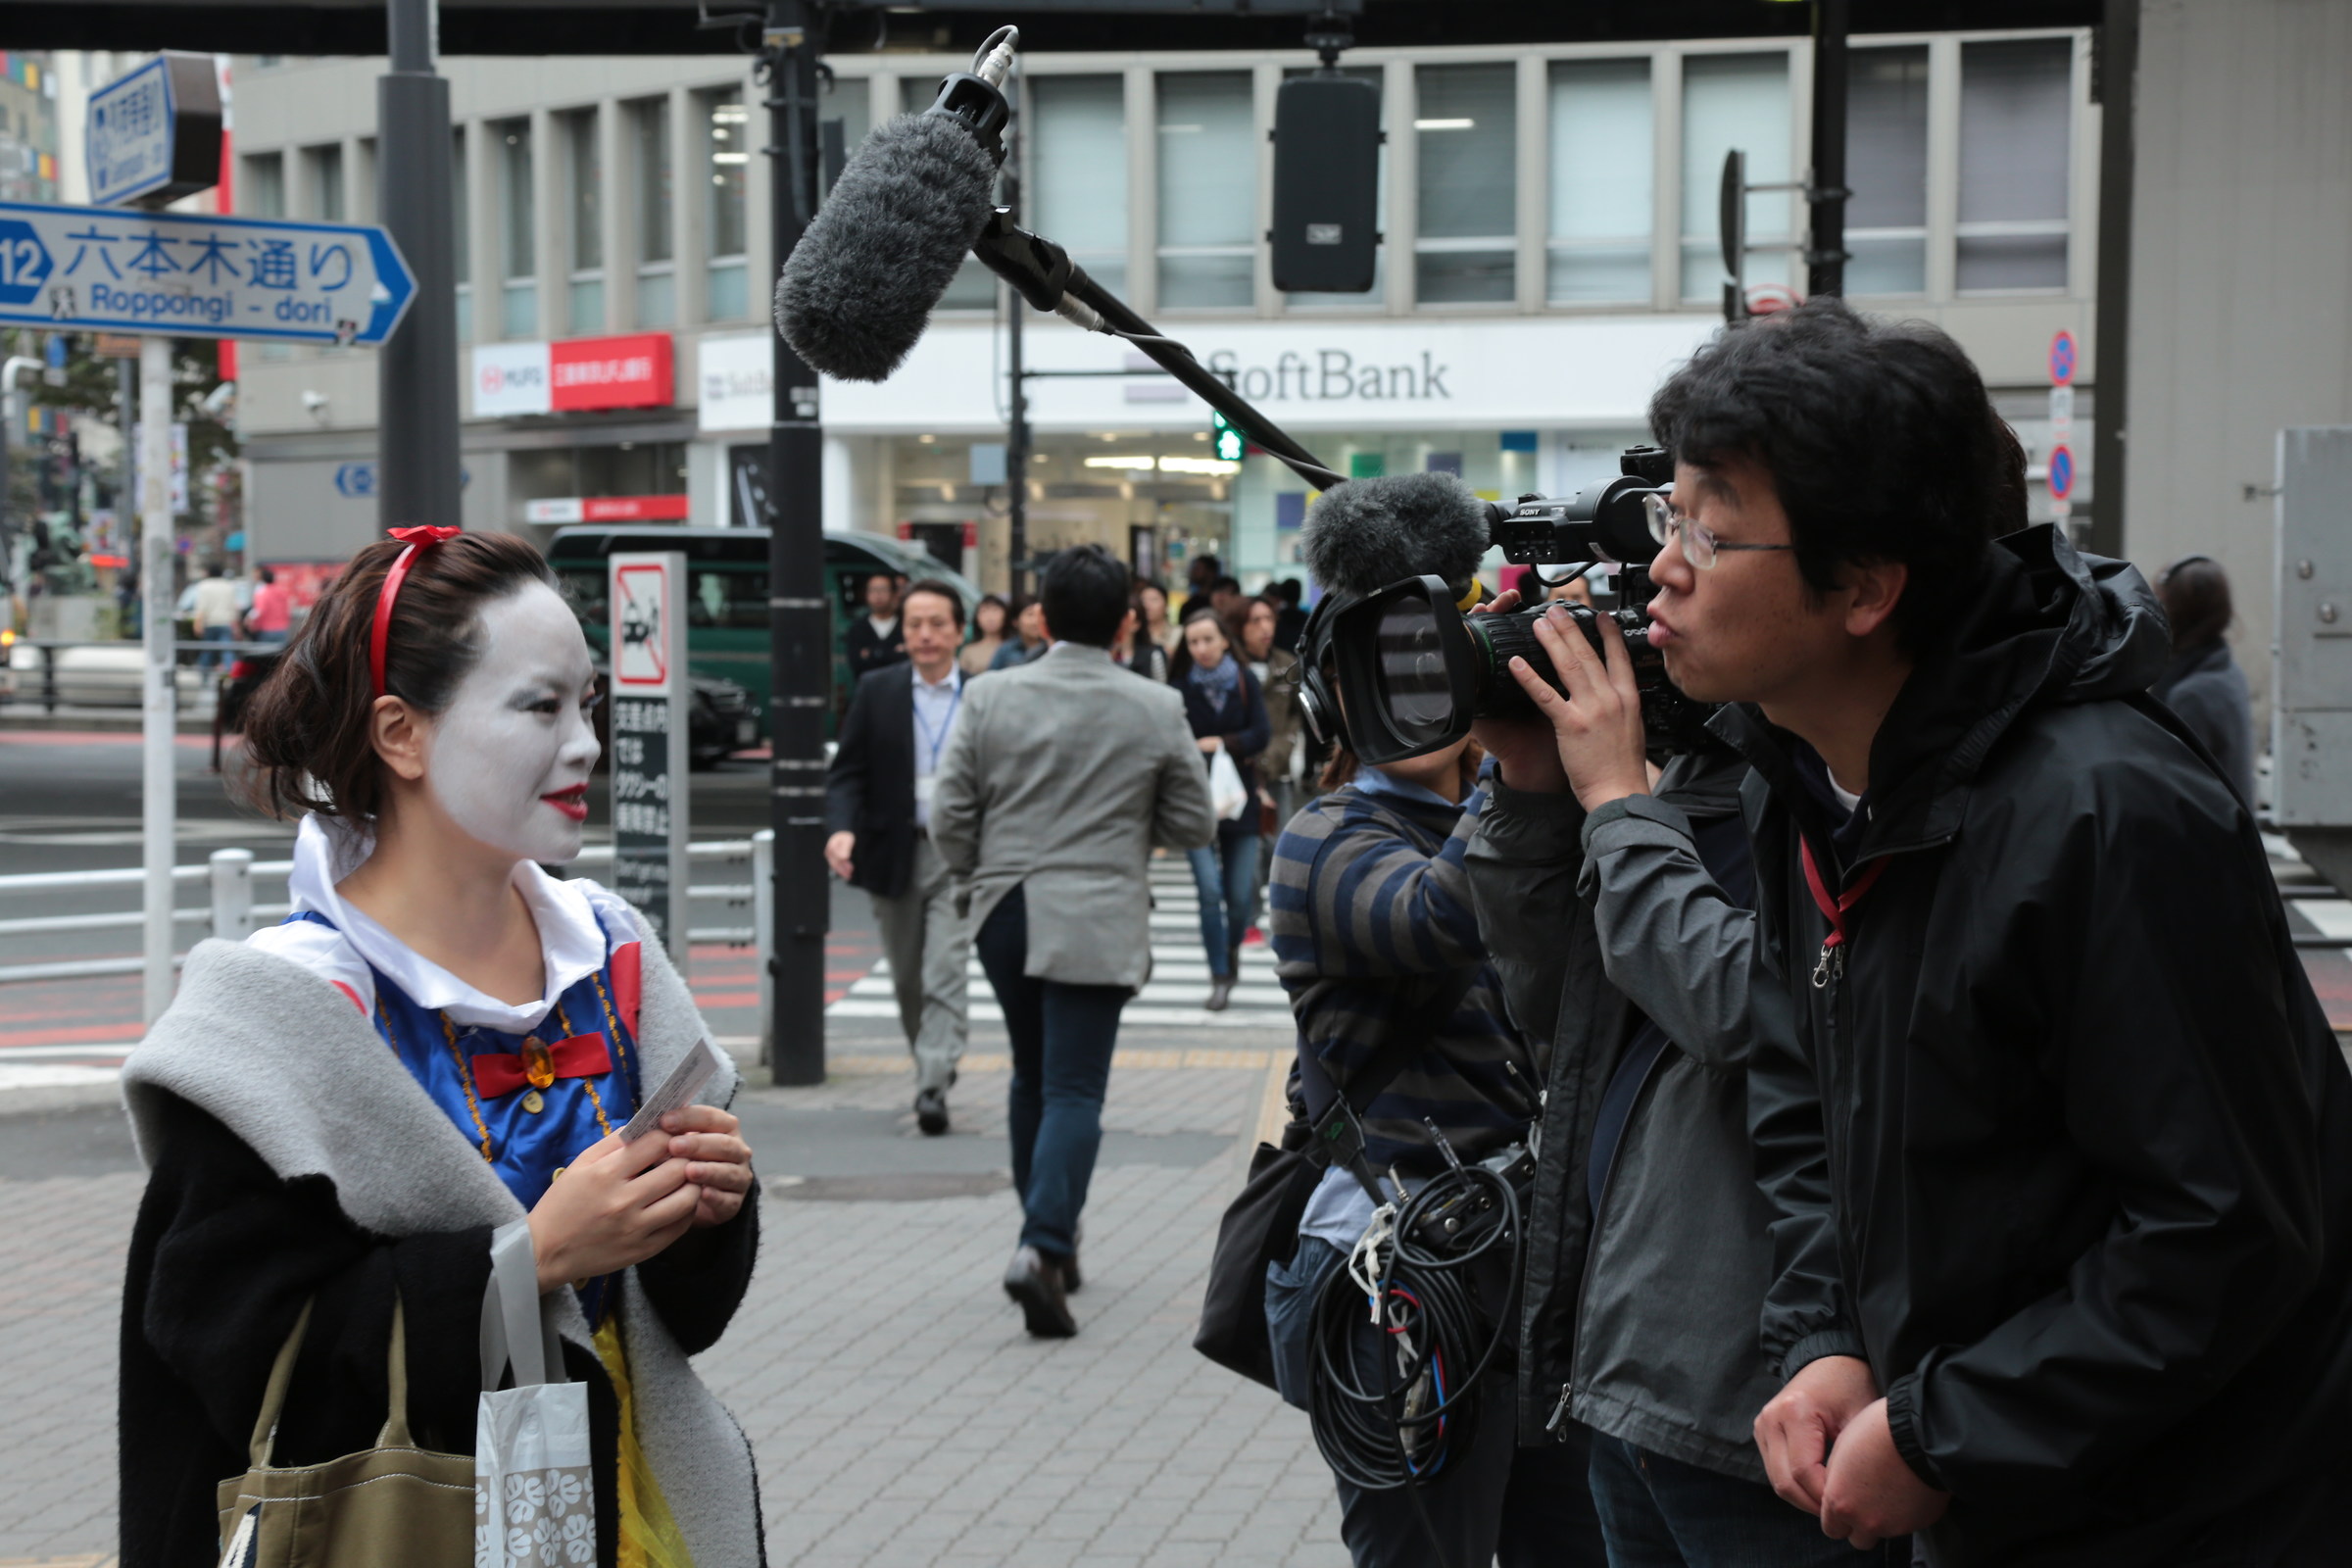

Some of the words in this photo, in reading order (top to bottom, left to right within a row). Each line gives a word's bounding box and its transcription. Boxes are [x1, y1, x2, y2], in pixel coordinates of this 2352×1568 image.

[0, 237, 43, 287] 12
[64, 224, 353, 291] 六本木通り
[90, 283, 233, 323] Roppongi
[275, 296, 332, 323] dori
